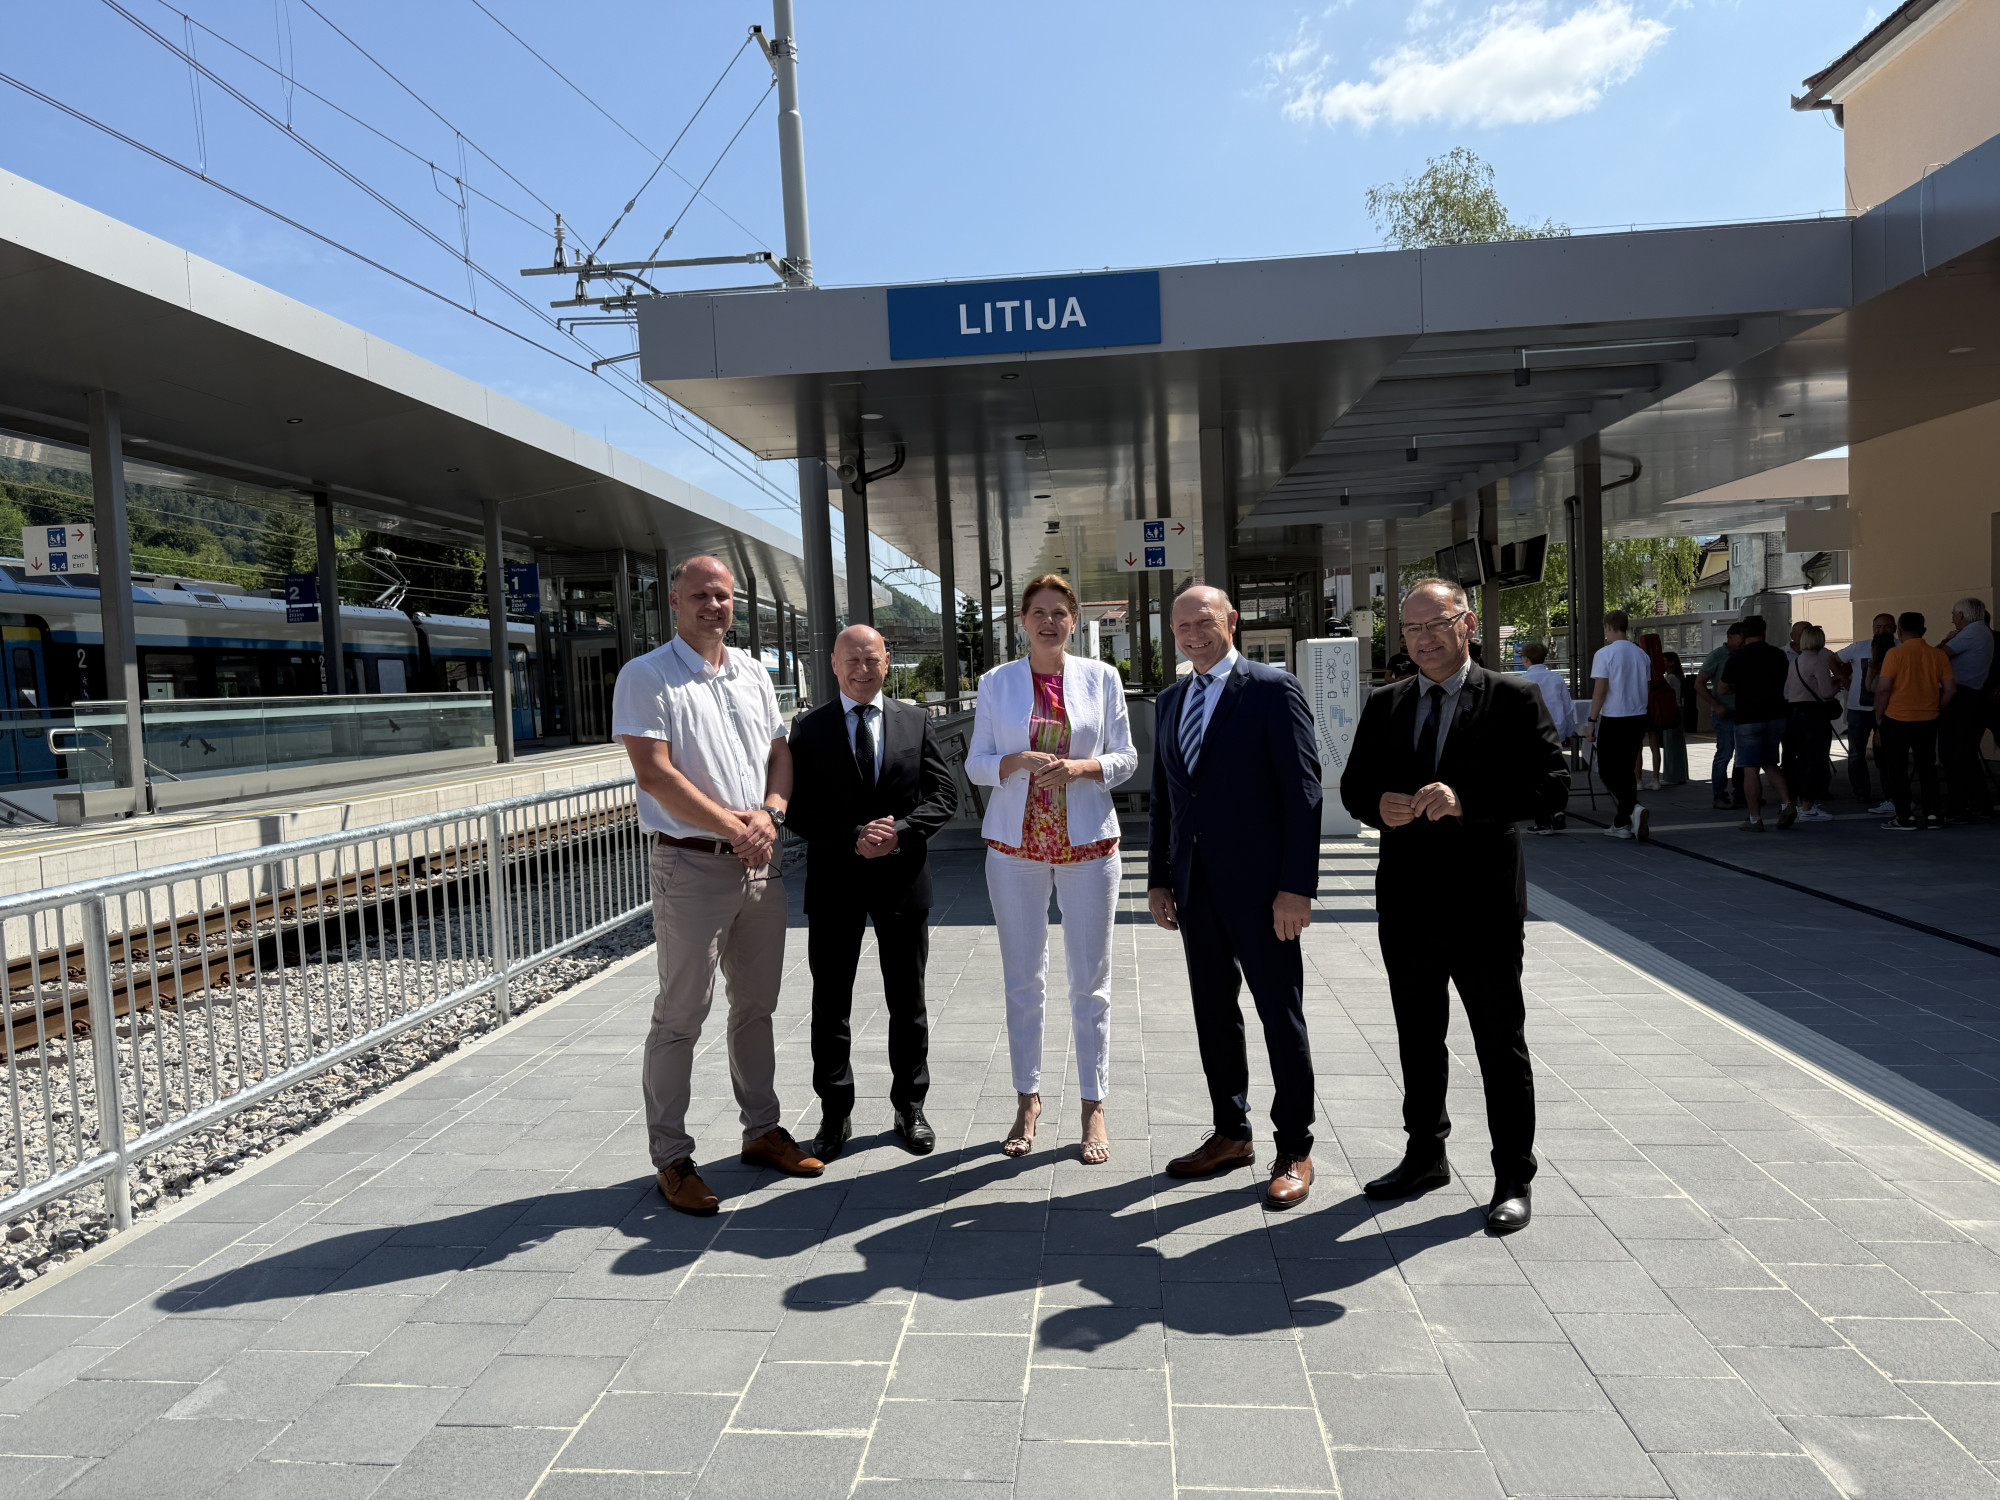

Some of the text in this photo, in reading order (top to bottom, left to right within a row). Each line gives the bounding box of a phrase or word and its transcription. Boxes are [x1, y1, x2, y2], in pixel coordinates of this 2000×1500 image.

[958, 296, 1087, 335] LITIJA
[51, 562, 67, 572] 3,4
[1147, 557, 1163, 566] 1-4
[512, 576, 518, 590] 1
[289, 586, 300, 600] 2
[77, 648, 87, 668] 2
